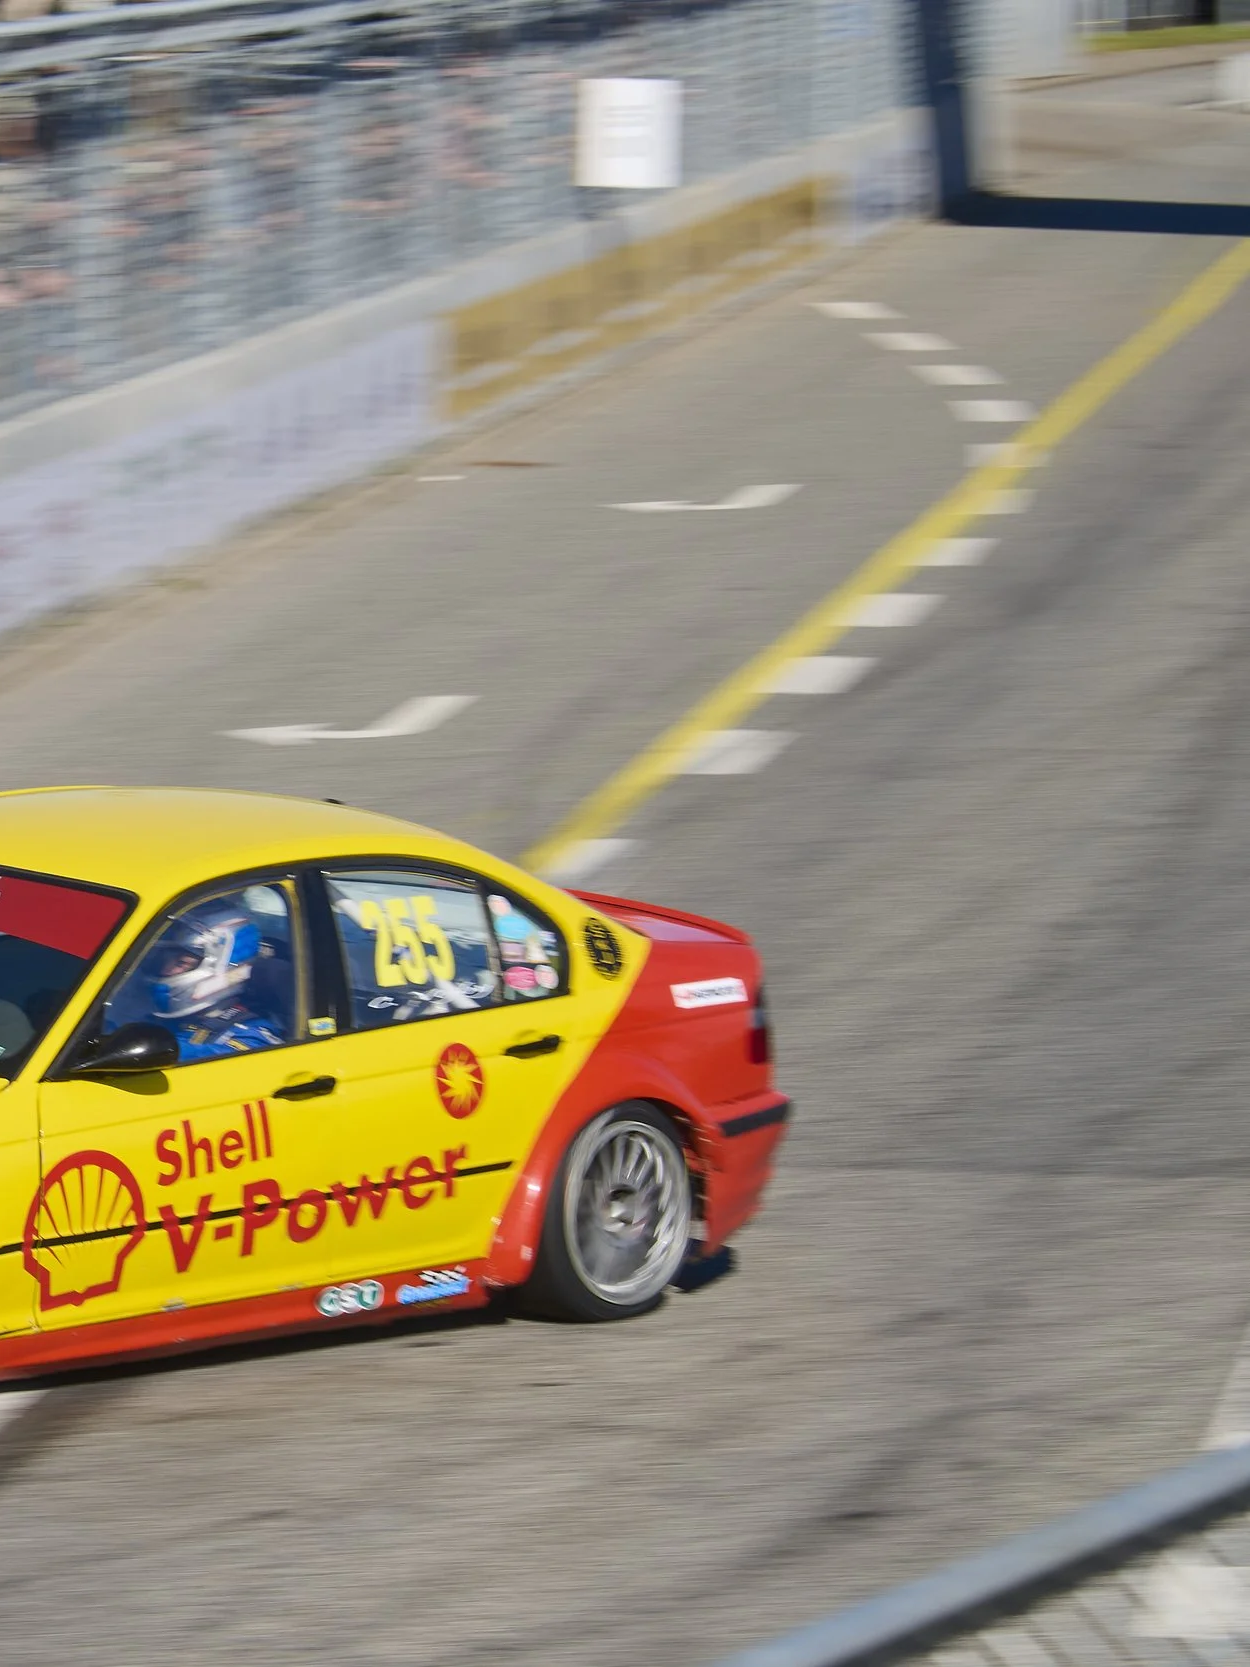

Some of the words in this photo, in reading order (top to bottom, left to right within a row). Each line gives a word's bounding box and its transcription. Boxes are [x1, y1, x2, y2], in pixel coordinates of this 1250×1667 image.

[360, 896, 455, 987] 255
[155, 1099, 274, 1187] Shell
[158, 1144, 469, 1274] V-Power
